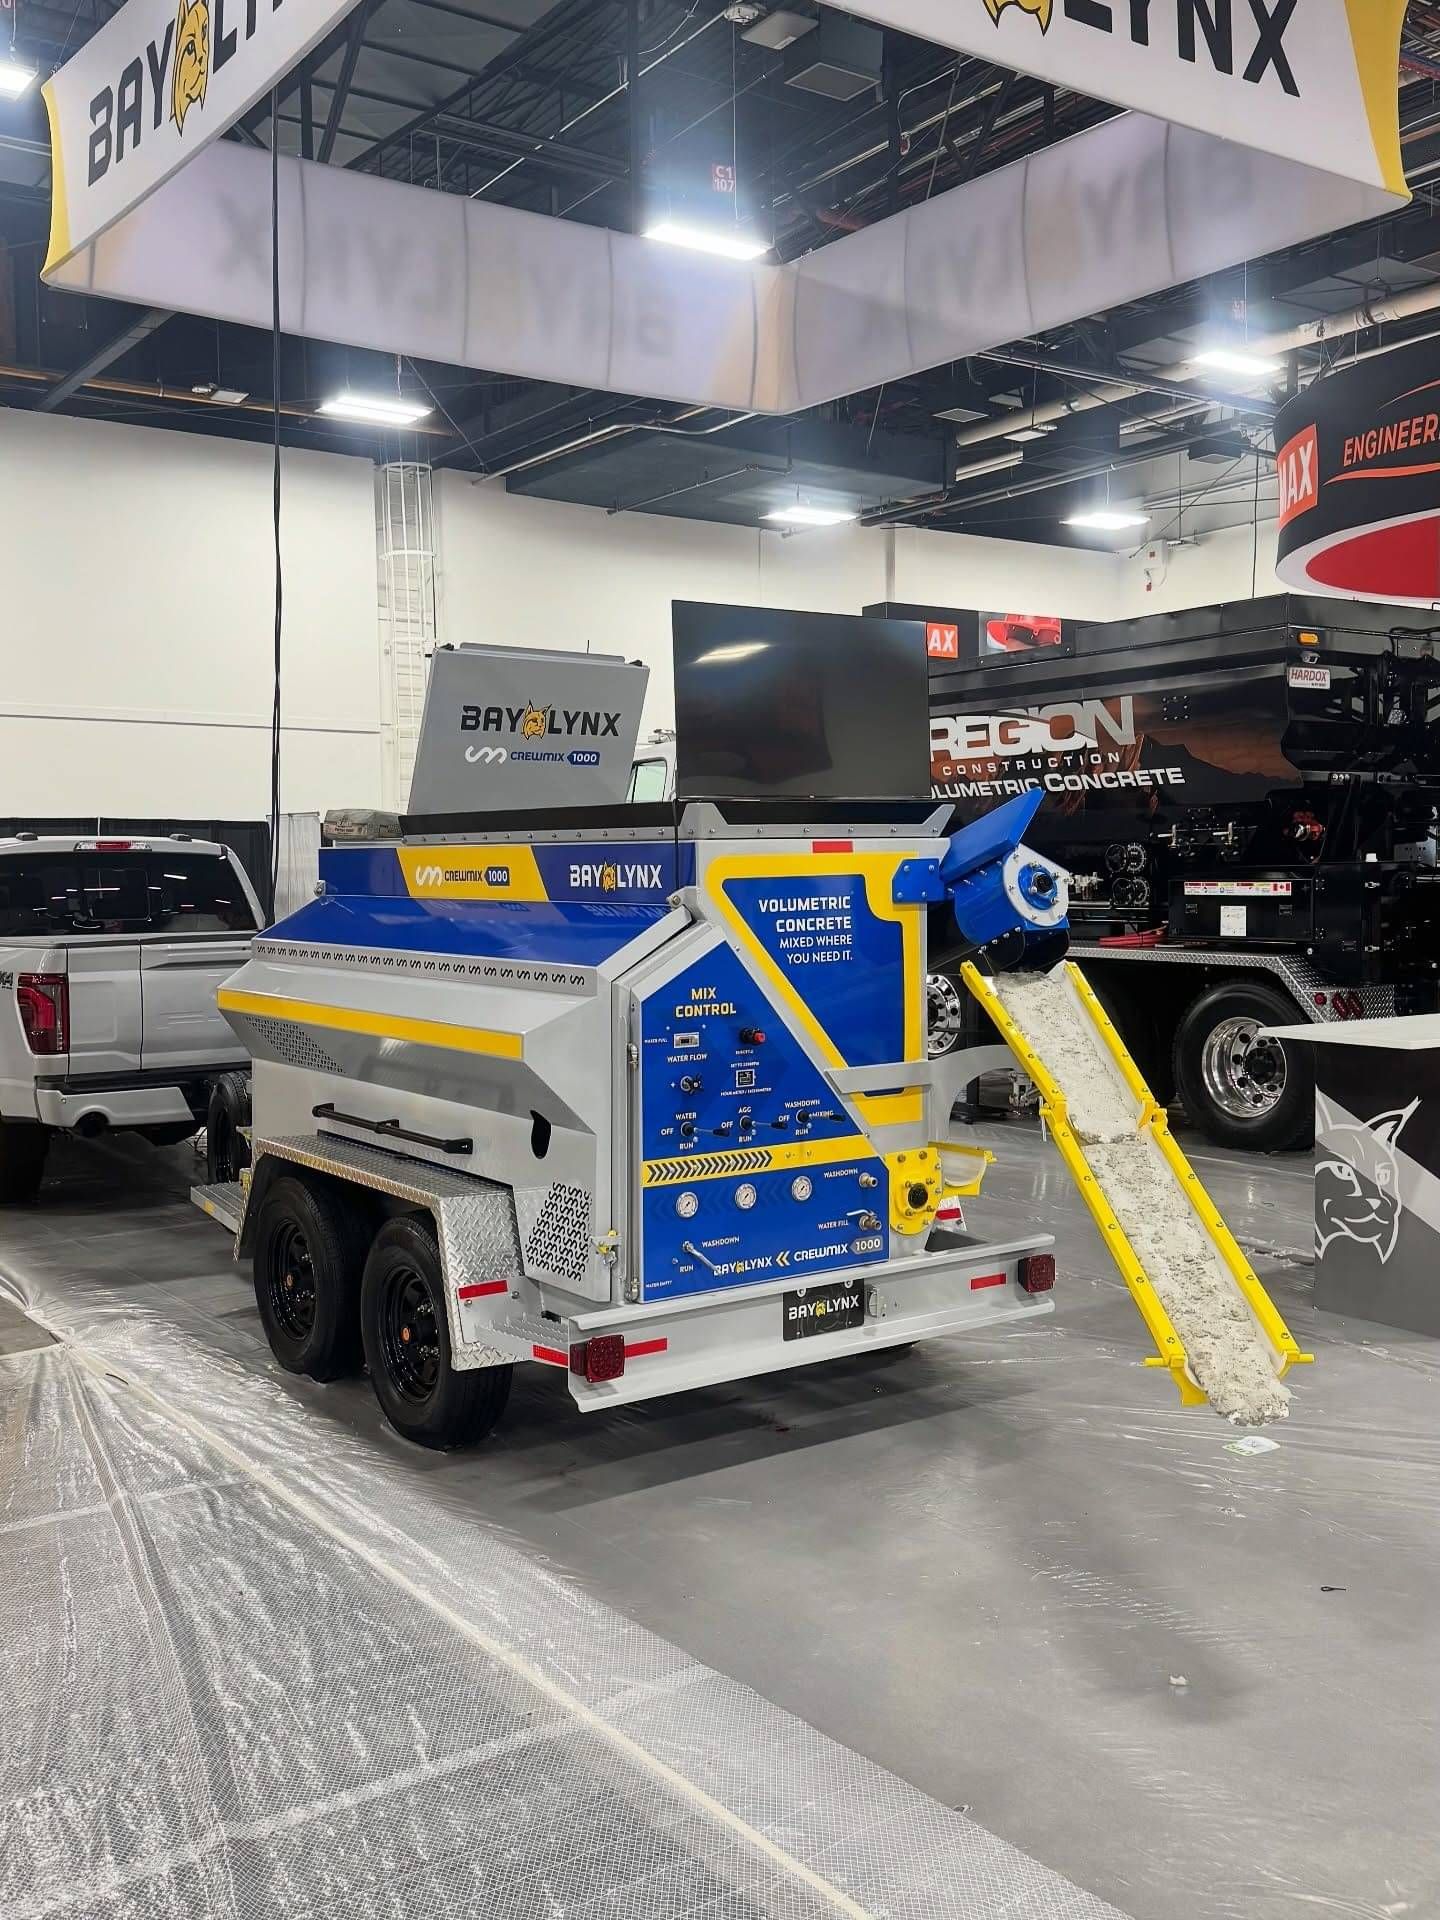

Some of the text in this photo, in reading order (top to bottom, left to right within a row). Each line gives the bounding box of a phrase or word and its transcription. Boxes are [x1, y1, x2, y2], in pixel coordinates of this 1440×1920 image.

[88, 18, 175, 187] BAY
[715, 166, 733, 179] C1
[714, 179, 734, 193] 107
[1343, 413, 1440, 467] ENGINEER
[1291, 669, 1327, 682] HARDOX
[461, 705, 622, 736] BAY LYNX
[929, 696, 1136, 762] REGION
[510, 751, 597, 763] CREWMIX 1000
[942, 752, 1120, 776] CONSTRUCTION
[1044, 767, 1185, 792] CONCRETE
[444, 869, 508, 882] CREWMIX 1000
[570, 864, 662, 888] BAY LYNX
[759, 896, 851, 912] VOLUMETRIC
[776, 916, 851, 932] CONCRETE
[780, 935, 852, 949] MIXED WHERE
[787, 950, 853, 965] YOU NEED IT.
[691, 987, 716, 1000] MIX
[675, 1002, 736, 1018] CONTROL
[667, 1053, 708, 1063] WATER FLOW
[785, 1099, 820, 1108] WASHDOWN
[676, 1112, 697, 1120] WATER
[661, 1127, 674, 1135] OFF
[795, 1128, 808, 1136] RUN
[738, 1135, 752, 1143] RUN
[679, 1142, 693, 1150] RUN
[824, 1168, 858, 1178] WASHDOWN
[818, 1222, 836, 1230] WATER
[702, 1236, 740, 1248] WASHDOWN
[794, 1238, 880, 1261] CREWMIX 1000
[680, 1264, 694, 1273] RUN
[714, 1256, 772, 1276] BAY LYNX
[788, 1294, 860, 1320] BAY LYNX
